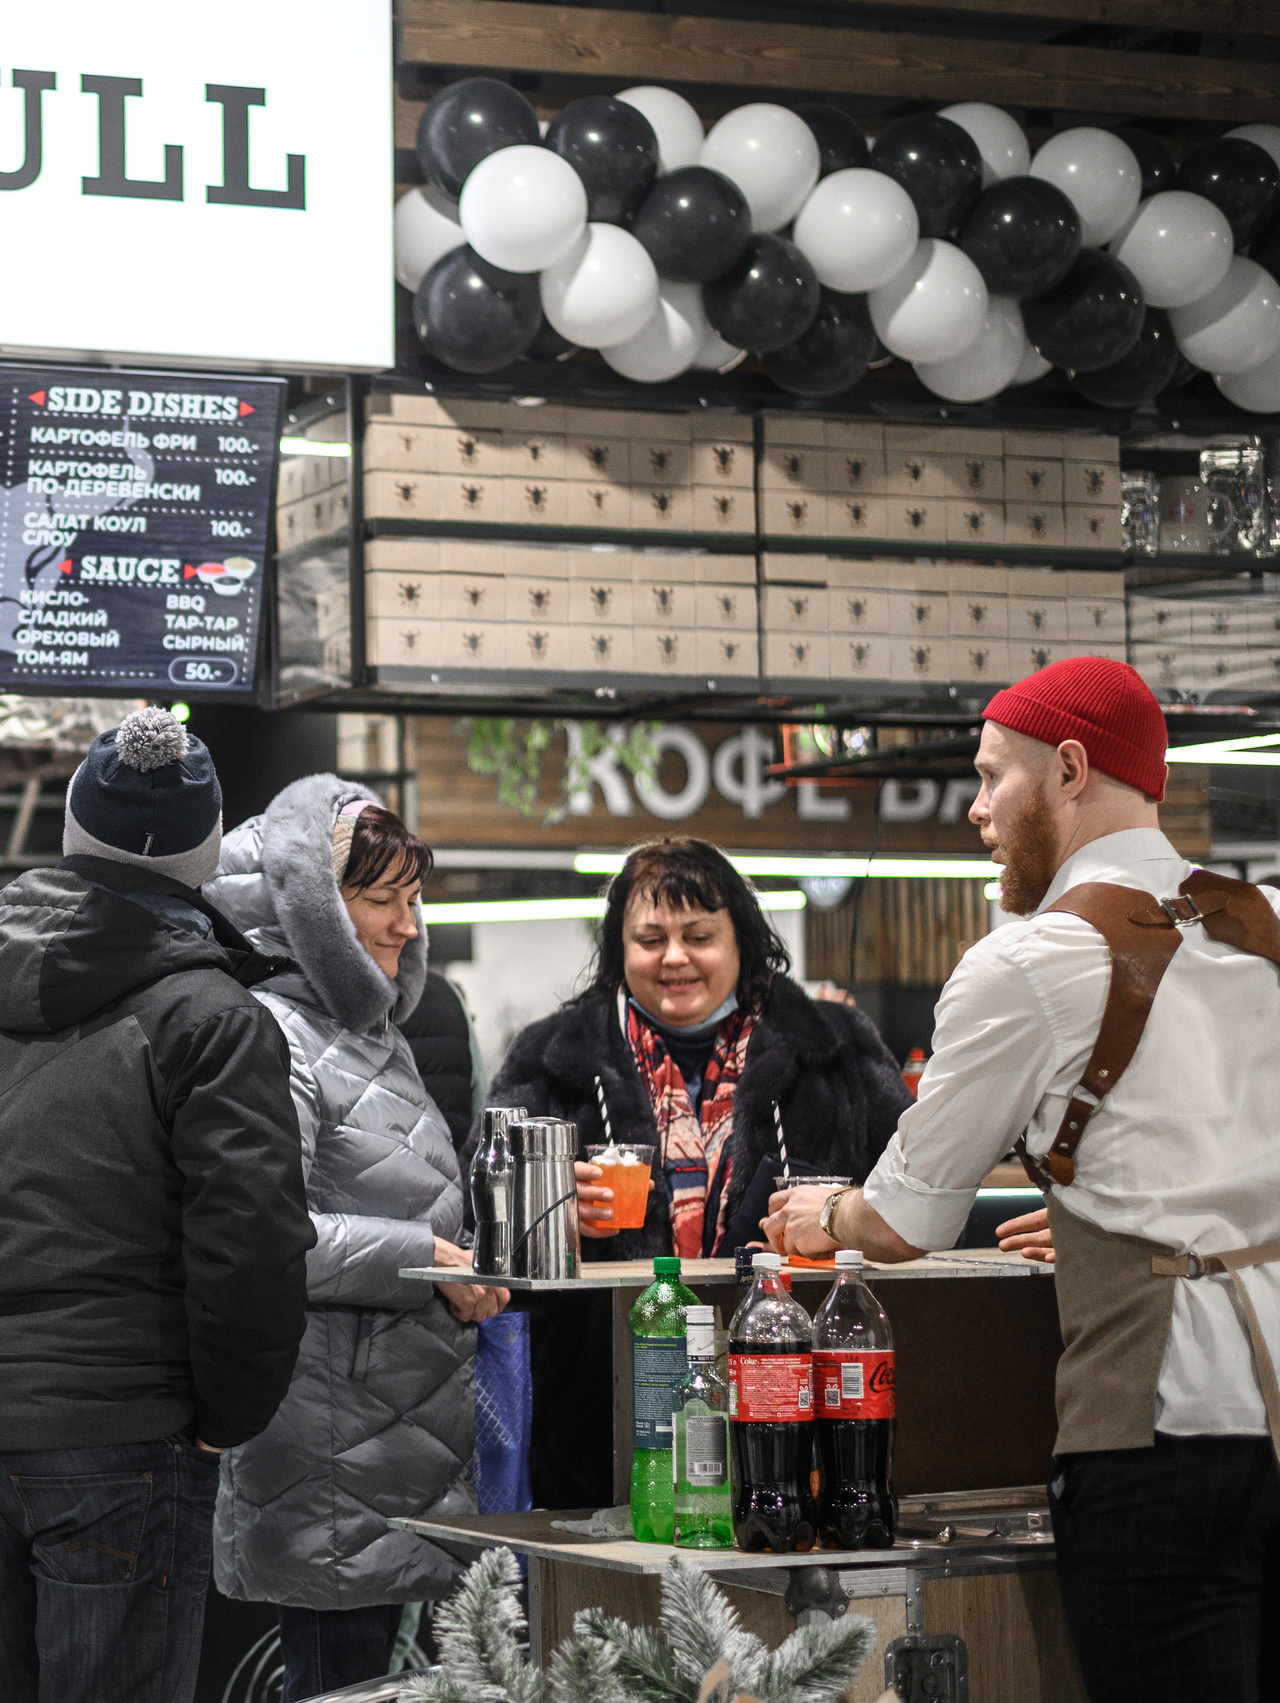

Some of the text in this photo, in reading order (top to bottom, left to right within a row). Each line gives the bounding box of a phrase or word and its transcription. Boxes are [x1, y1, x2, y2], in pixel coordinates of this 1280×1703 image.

[48, 386, 239, 421] SIDE DISHES
[30, 427, 197, 452] КАРТОФЕЛЬ ФРИ
[28, 459, 147, 481] КАРТОФЕЛЬ
[27, 477, 201, 501] ПО-ДЕРЕВЕНСКИ
[24, 512, 147, 534] САЛАТ КОУЛ
[23, 530, 77, 548] СЛОУ
[81, 555, 181, 584] SAUCE
[20, 589, 90, 607] КИСЛО-
[166, 594, 206, 613] BBQ
[18, 608, 108, 628] СЛАДКИЙ
[165, 614, 238, 632] ТАР-ТАР
[16, 629, 120, 648] ОРЕХОВЫЙ
[163, 634, 246, 652] СЫРНЫЙ
[16, 650, 89, 666] ТОМ-ЯМ
[740, 1357, 757, 1365] Coke
